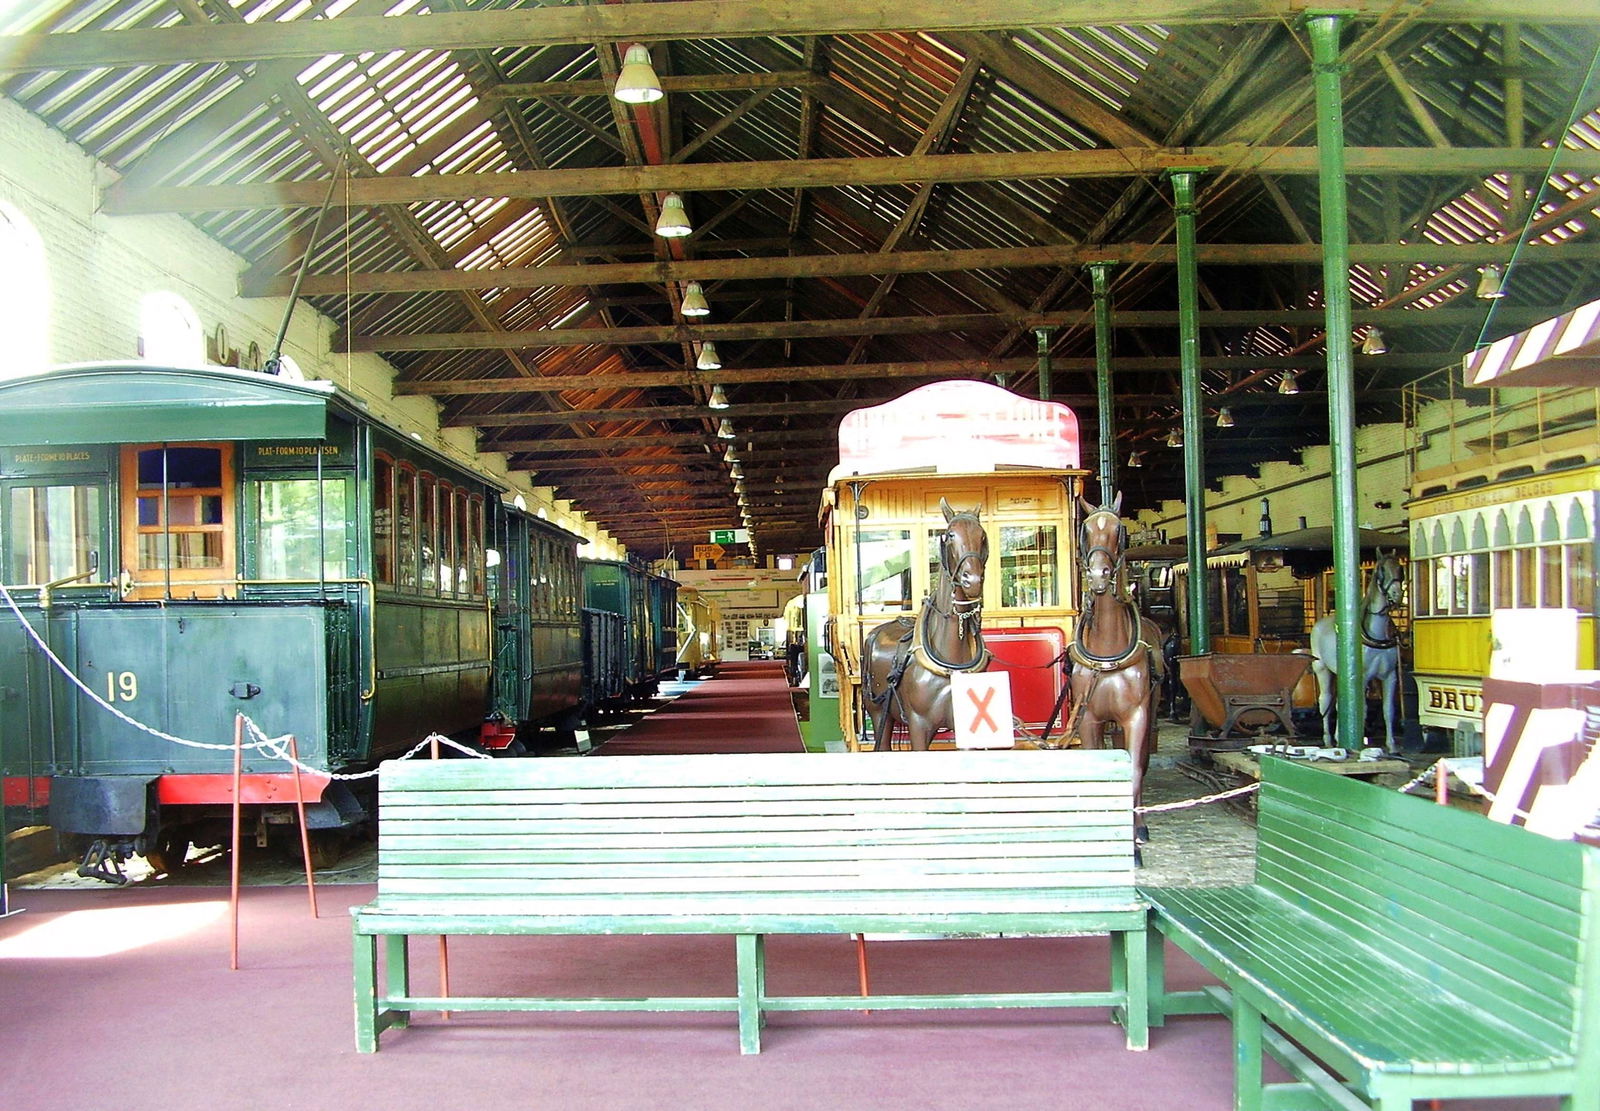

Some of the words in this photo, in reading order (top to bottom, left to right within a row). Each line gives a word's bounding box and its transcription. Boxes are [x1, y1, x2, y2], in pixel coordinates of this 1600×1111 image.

[304, 446, 338, 455] PLATSEN
[107, 671, 137, 702] 19
[1428, 686, 1483, 713] BRU
